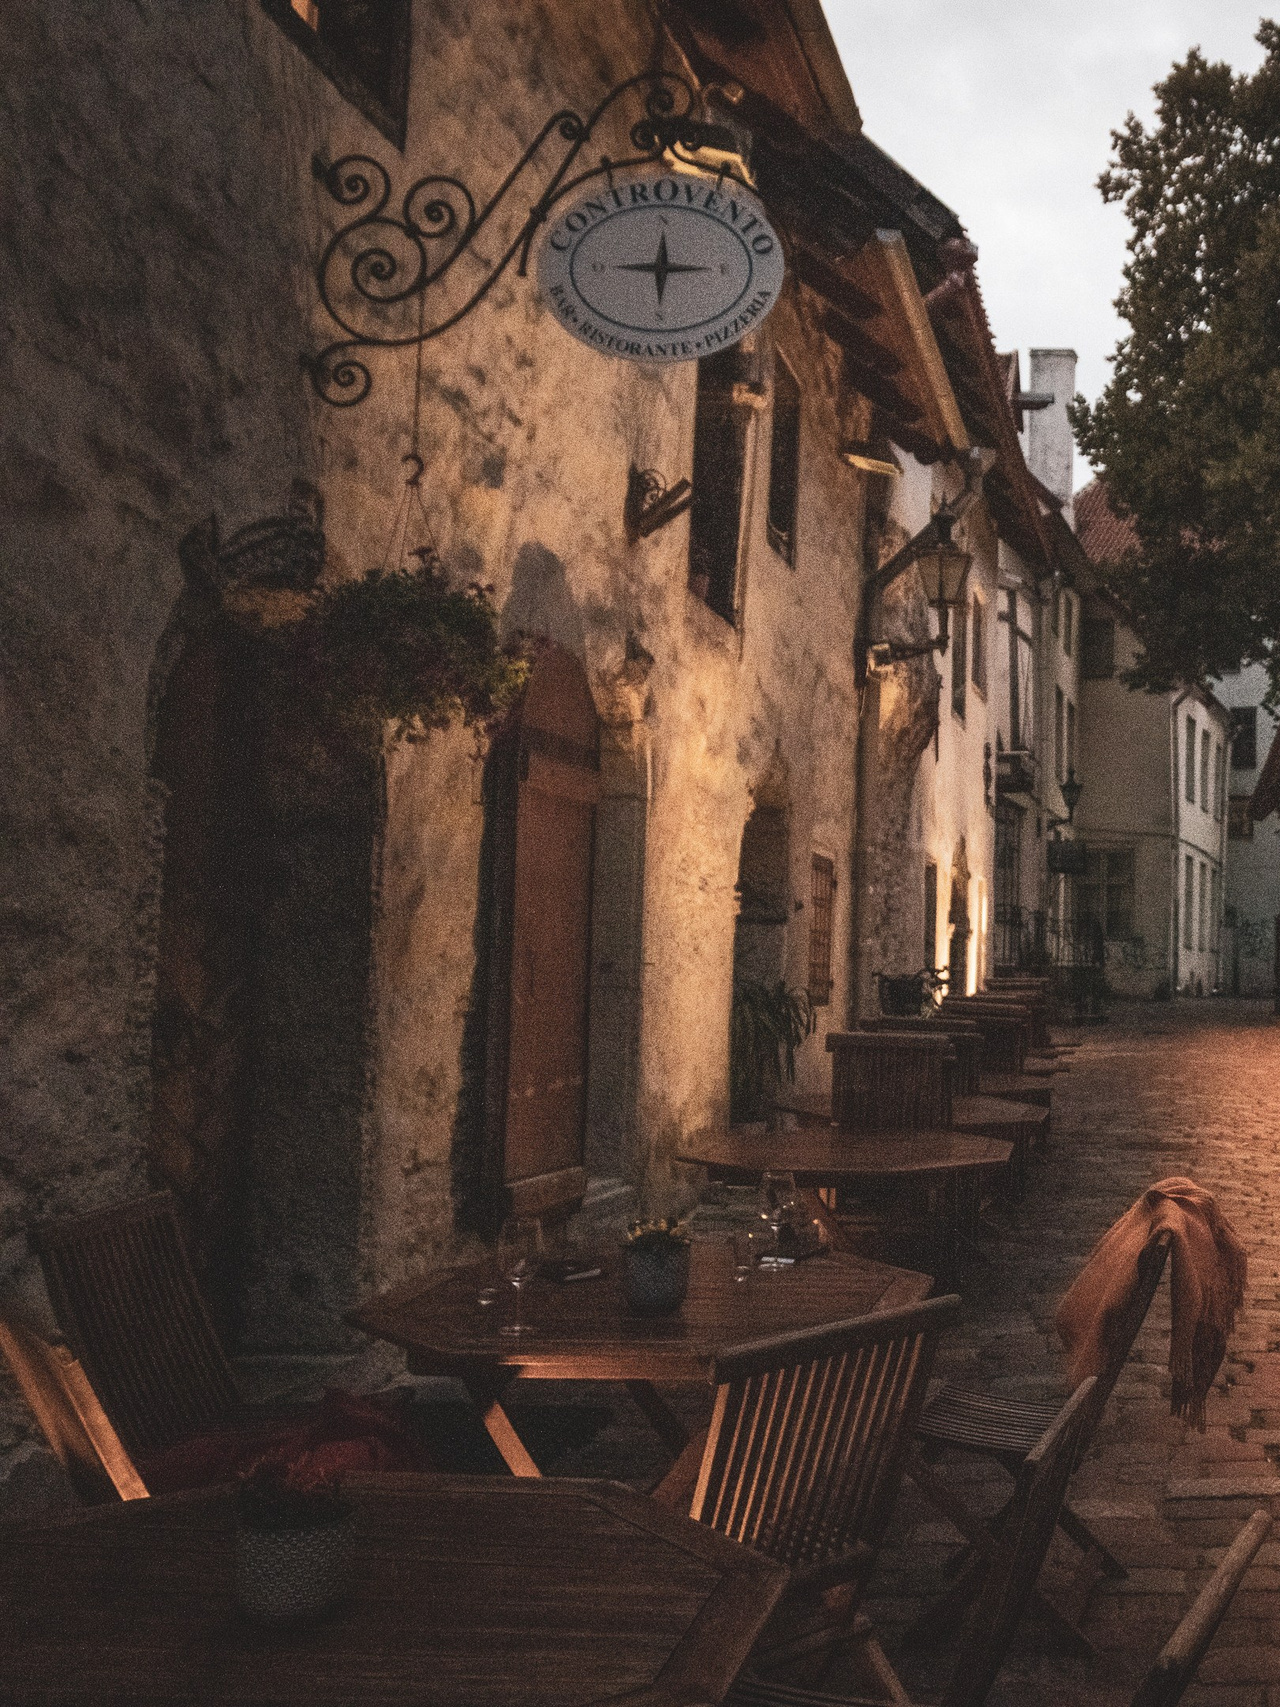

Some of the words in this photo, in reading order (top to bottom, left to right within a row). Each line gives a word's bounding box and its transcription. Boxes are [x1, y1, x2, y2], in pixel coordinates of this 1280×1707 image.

[550, 178, 774, 256] CONTROVENTO
[550, 284, 576, 319] BAR
[578, 320, 692, 357] RISTORANTE
[704, 289, 772, 349] PIZZERIA
